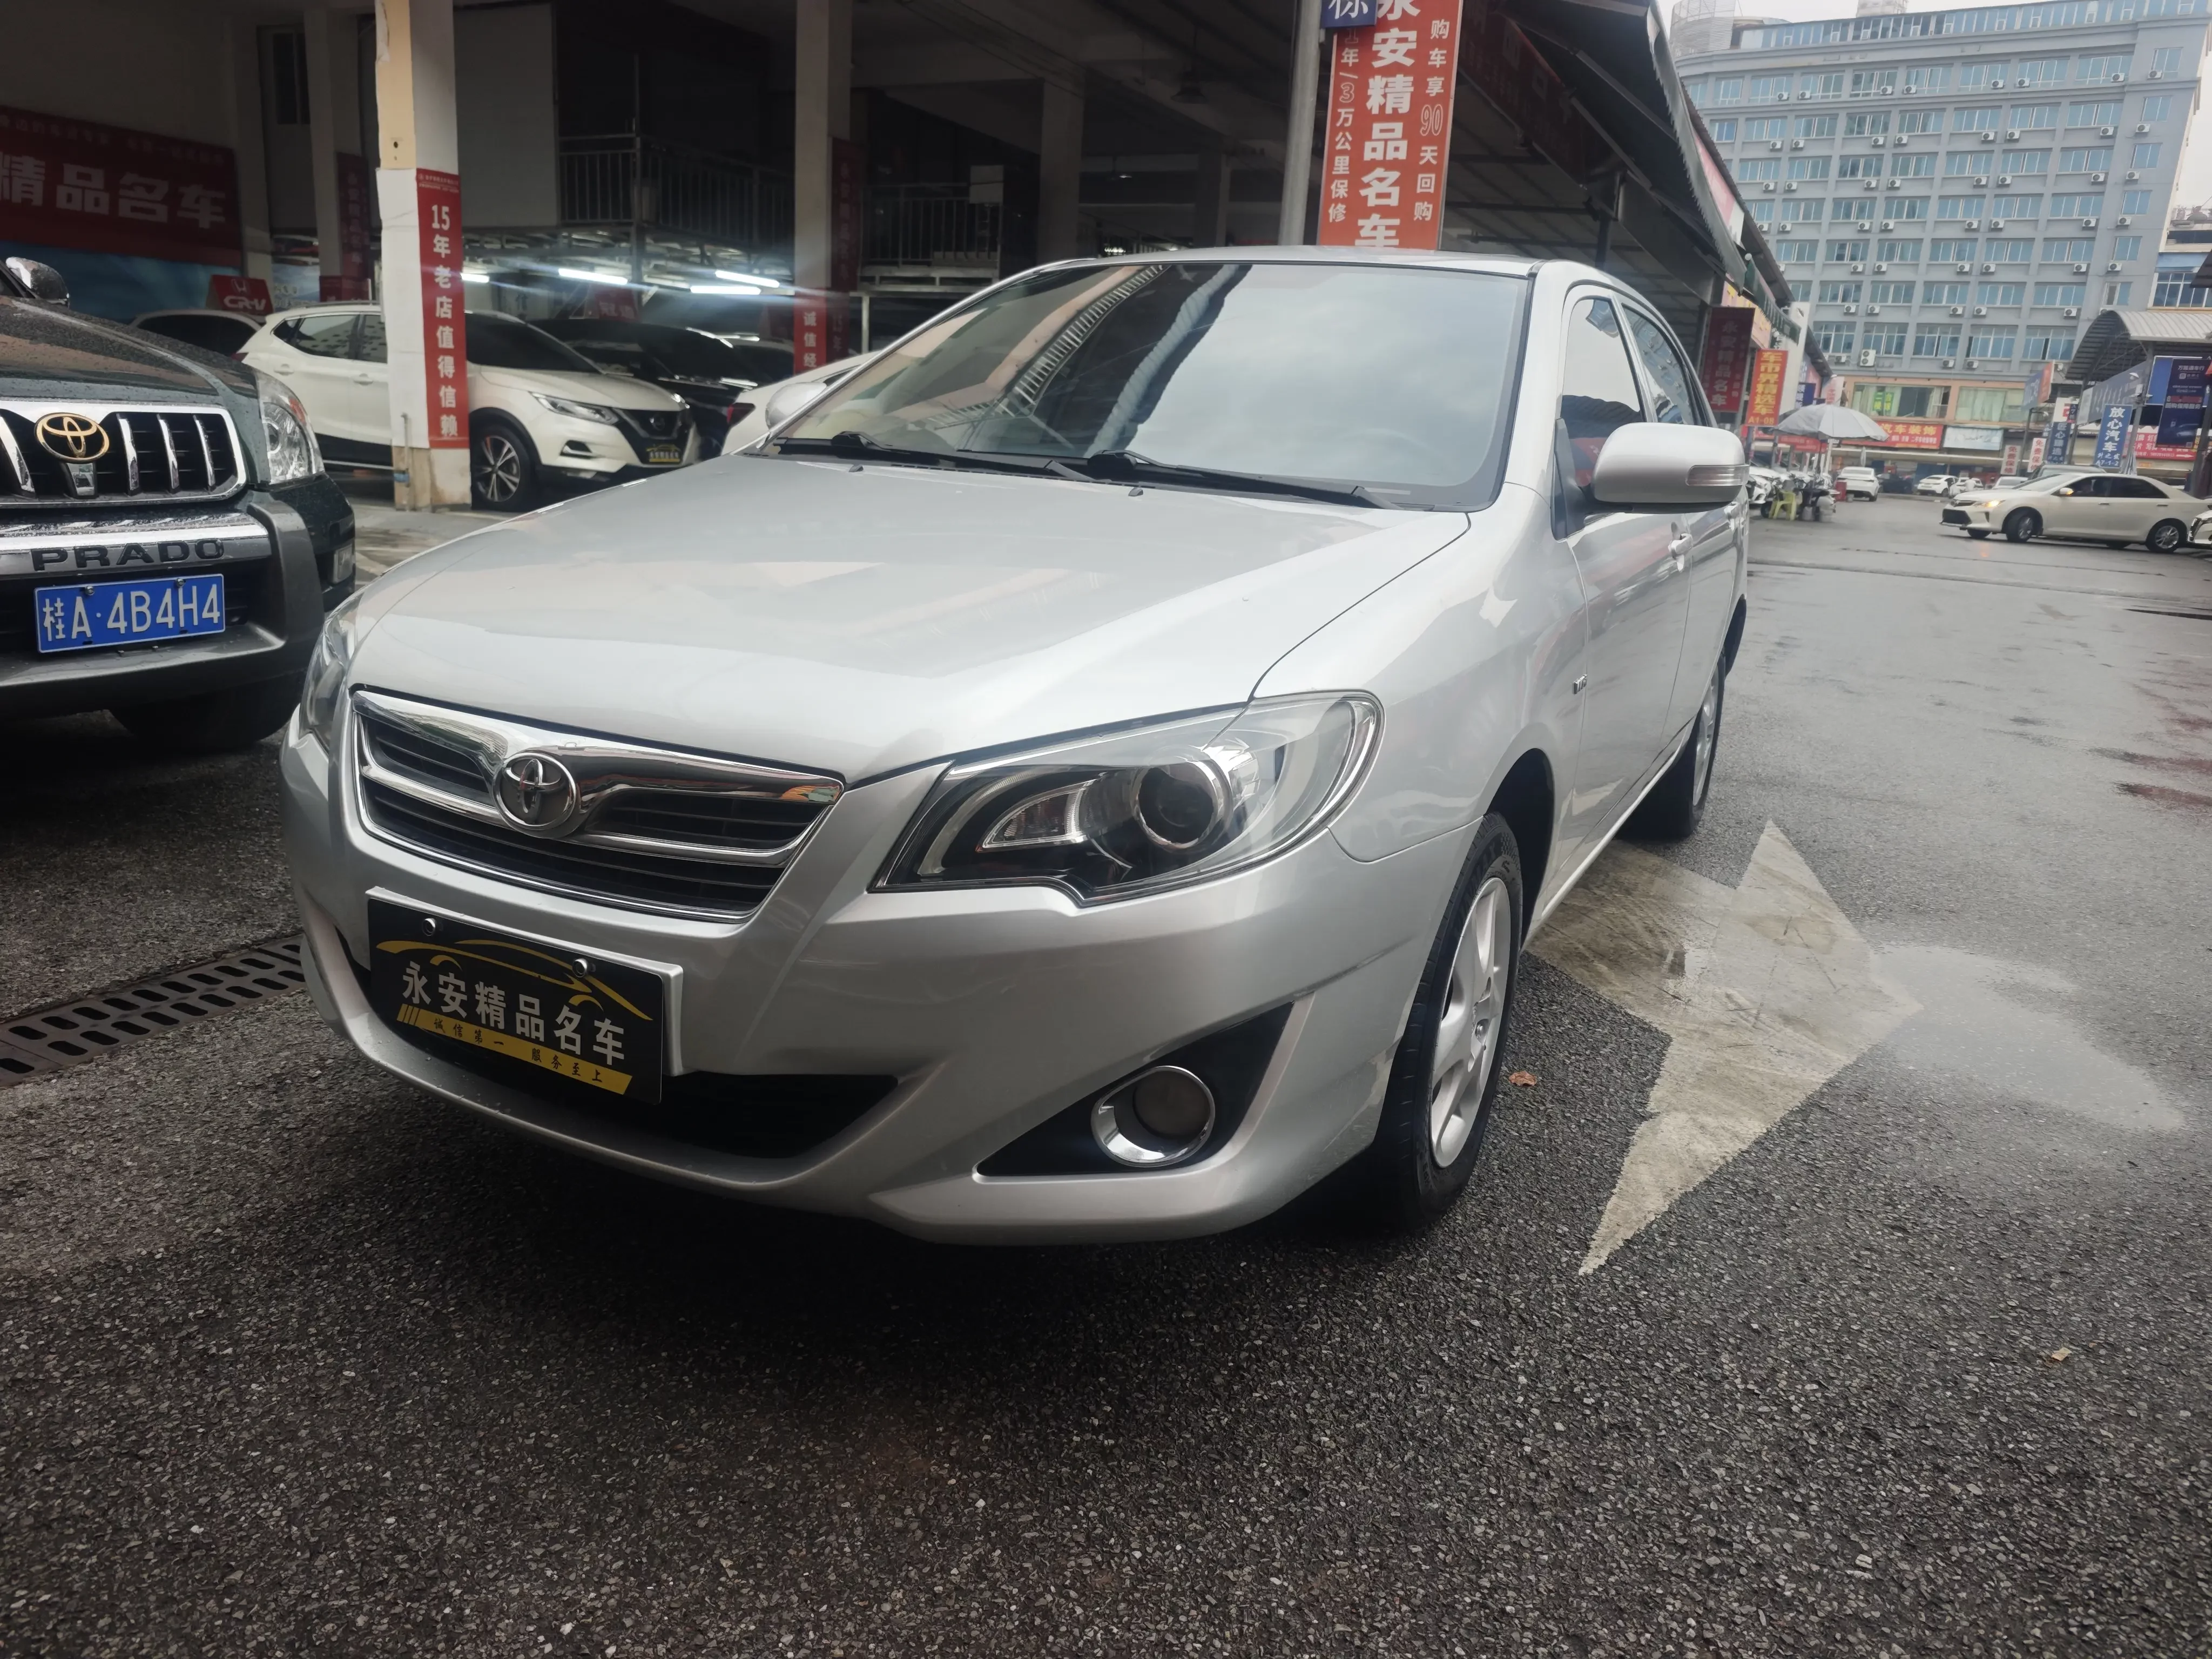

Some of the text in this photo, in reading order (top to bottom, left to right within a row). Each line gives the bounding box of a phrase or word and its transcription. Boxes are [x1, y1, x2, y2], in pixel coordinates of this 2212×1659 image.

[1414, 19, 1450, 221] 购车享90天回购
[0, 151, 226, 230] 精品名车
[431, 204, 458, 437] 15年老店值得信赖
[2102, 407, 2125, 453] 放心汽车
[30, 538, 225, 571] PRADO
[402, 960, 625, 1065] 永安精品名车
[434, 1017, 603, 1084] 诚信第一 服务至上
